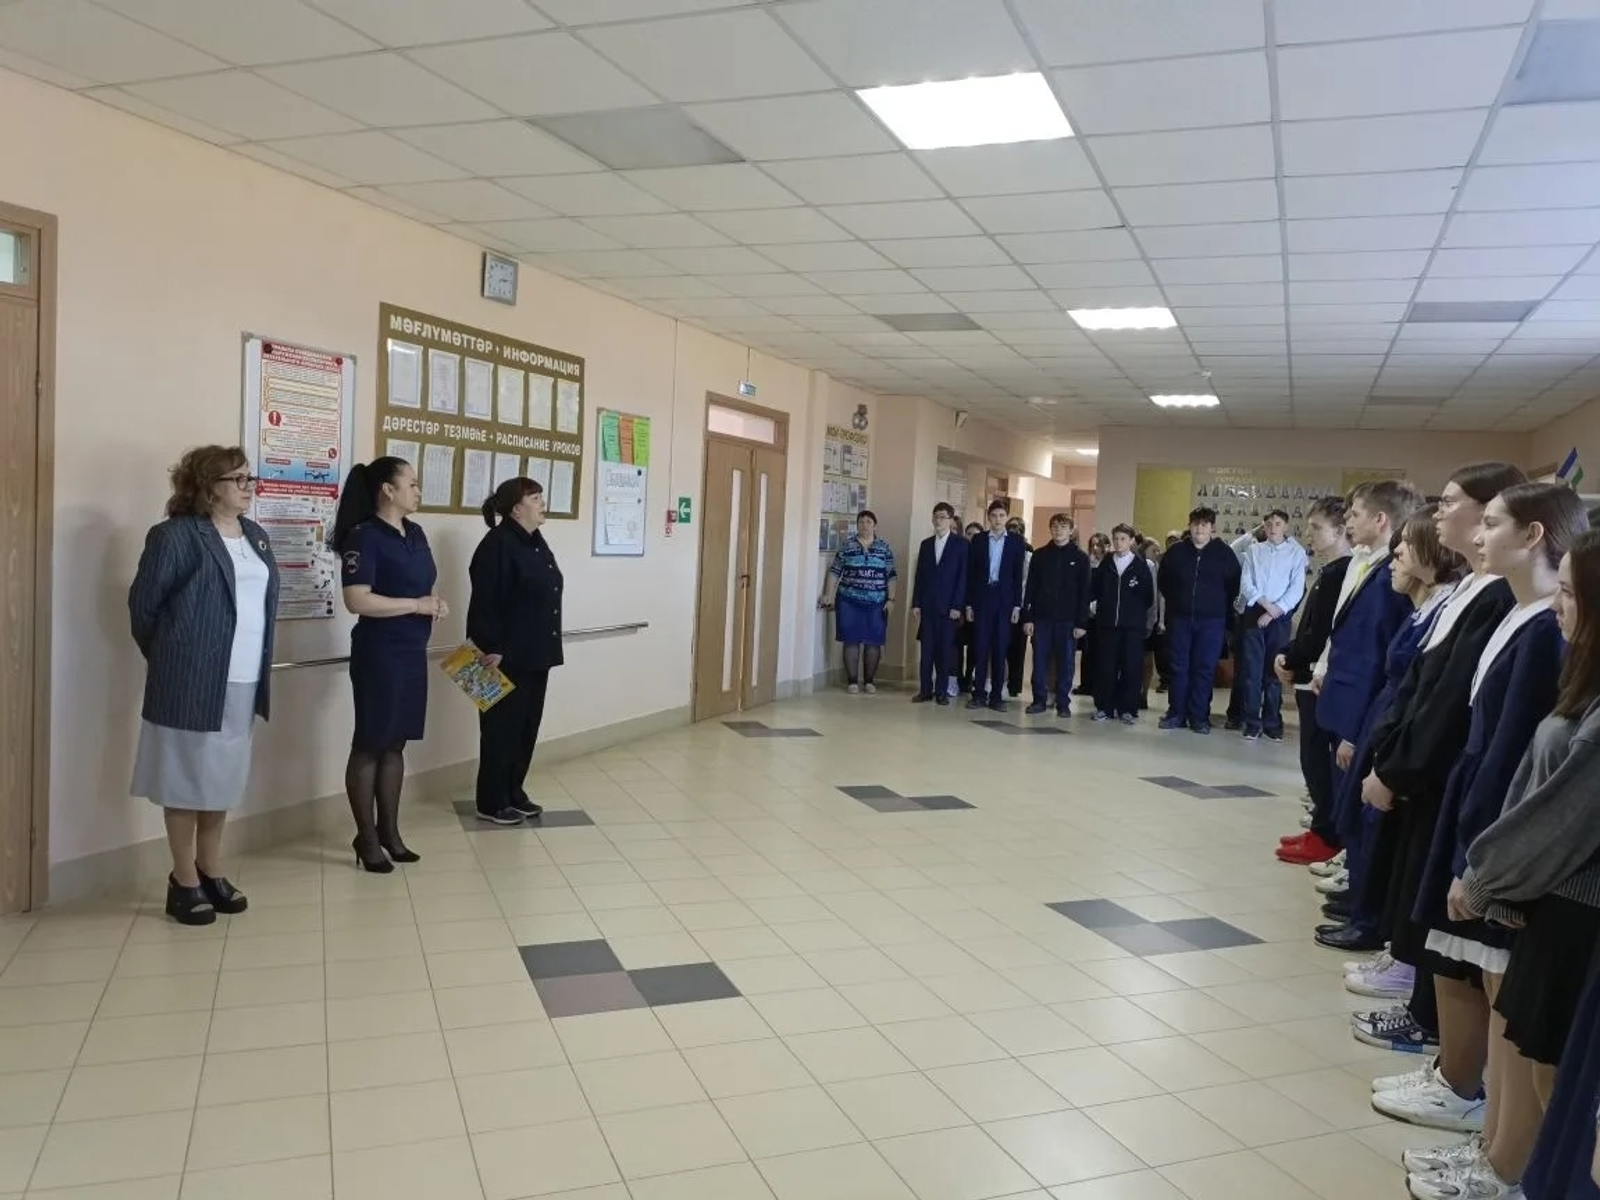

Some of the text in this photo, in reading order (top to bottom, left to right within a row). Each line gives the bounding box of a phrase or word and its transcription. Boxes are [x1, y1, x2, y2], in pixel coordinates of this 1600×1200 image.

[390, 314, 580, 376] МӘҒЛҮМӘТТӘР ИНФОРМАЦИЯ
[382, 415, 440, 435] ДӘРЕСТӘР
[496, 432, 550, 452] РАСПИСАНИЕ
[552, 441, 581, 456] УРОКОВ
